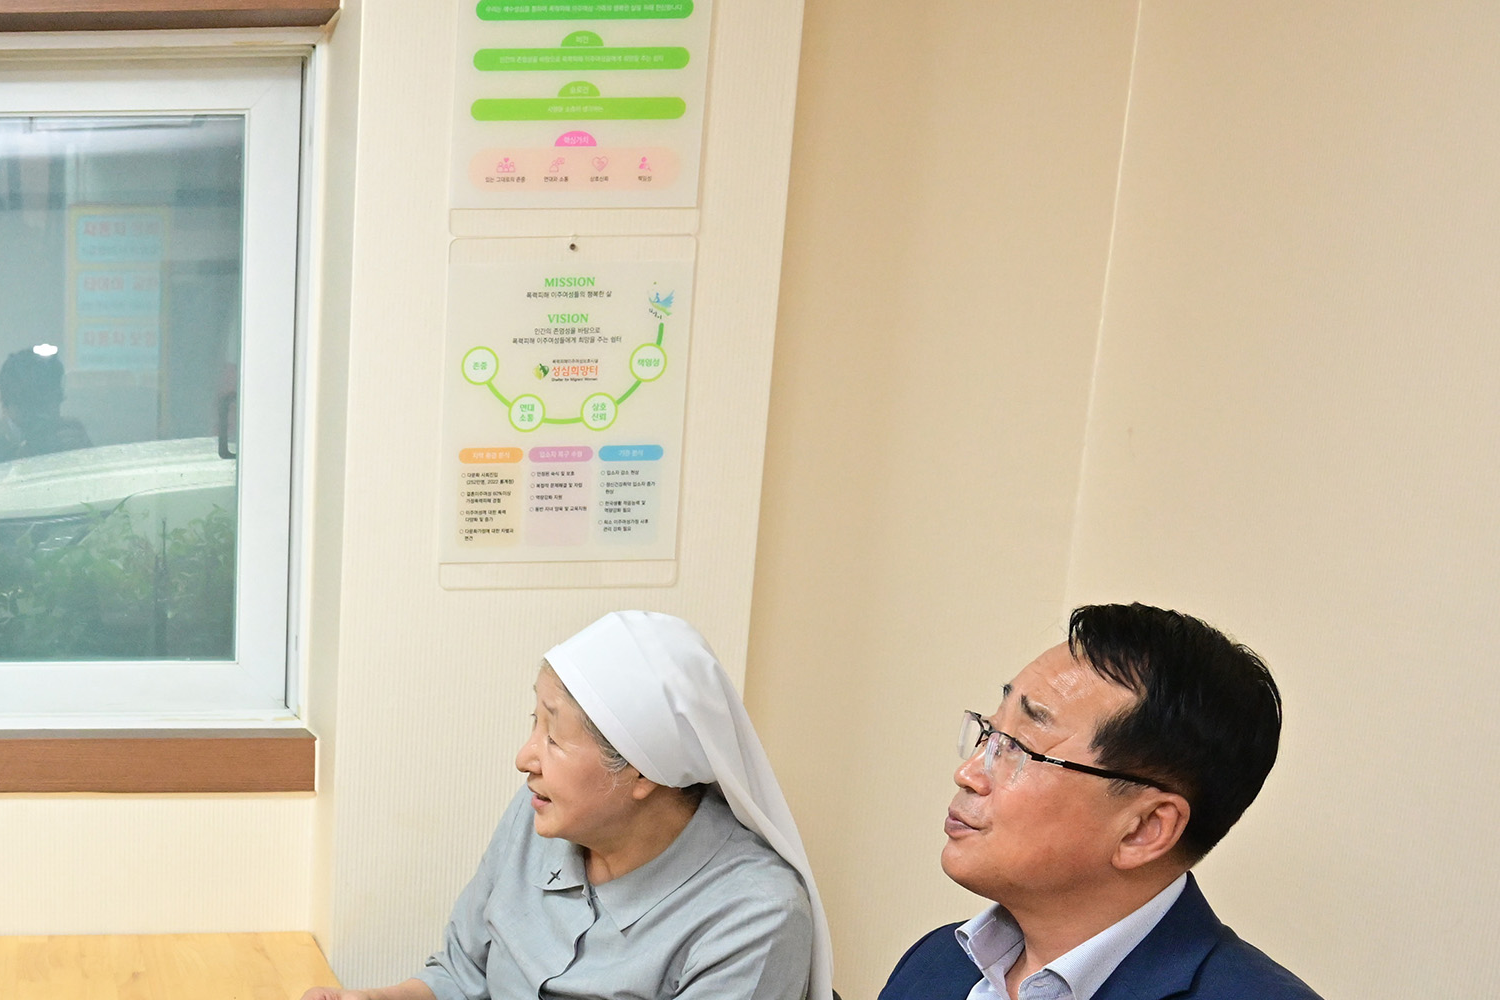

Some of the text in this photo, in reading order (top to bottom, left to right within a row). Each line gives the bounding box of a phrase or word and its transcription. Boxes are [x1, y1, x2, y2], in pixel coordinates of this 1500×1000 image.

[544, 277, 596, 288] MISSION
[547, 314, 589, 324] VISION
[472, 362, 488, 370] 존중
[637, 358, 660, 367] 책임성
[551, 365, 599, 376] 성심희망터
[519, 404, 535, 412] 연대
[592, 403, 607, 411] 상호
[519, 414, 534, 422] 소통
[591, 413, 607, 422] 신뢰
